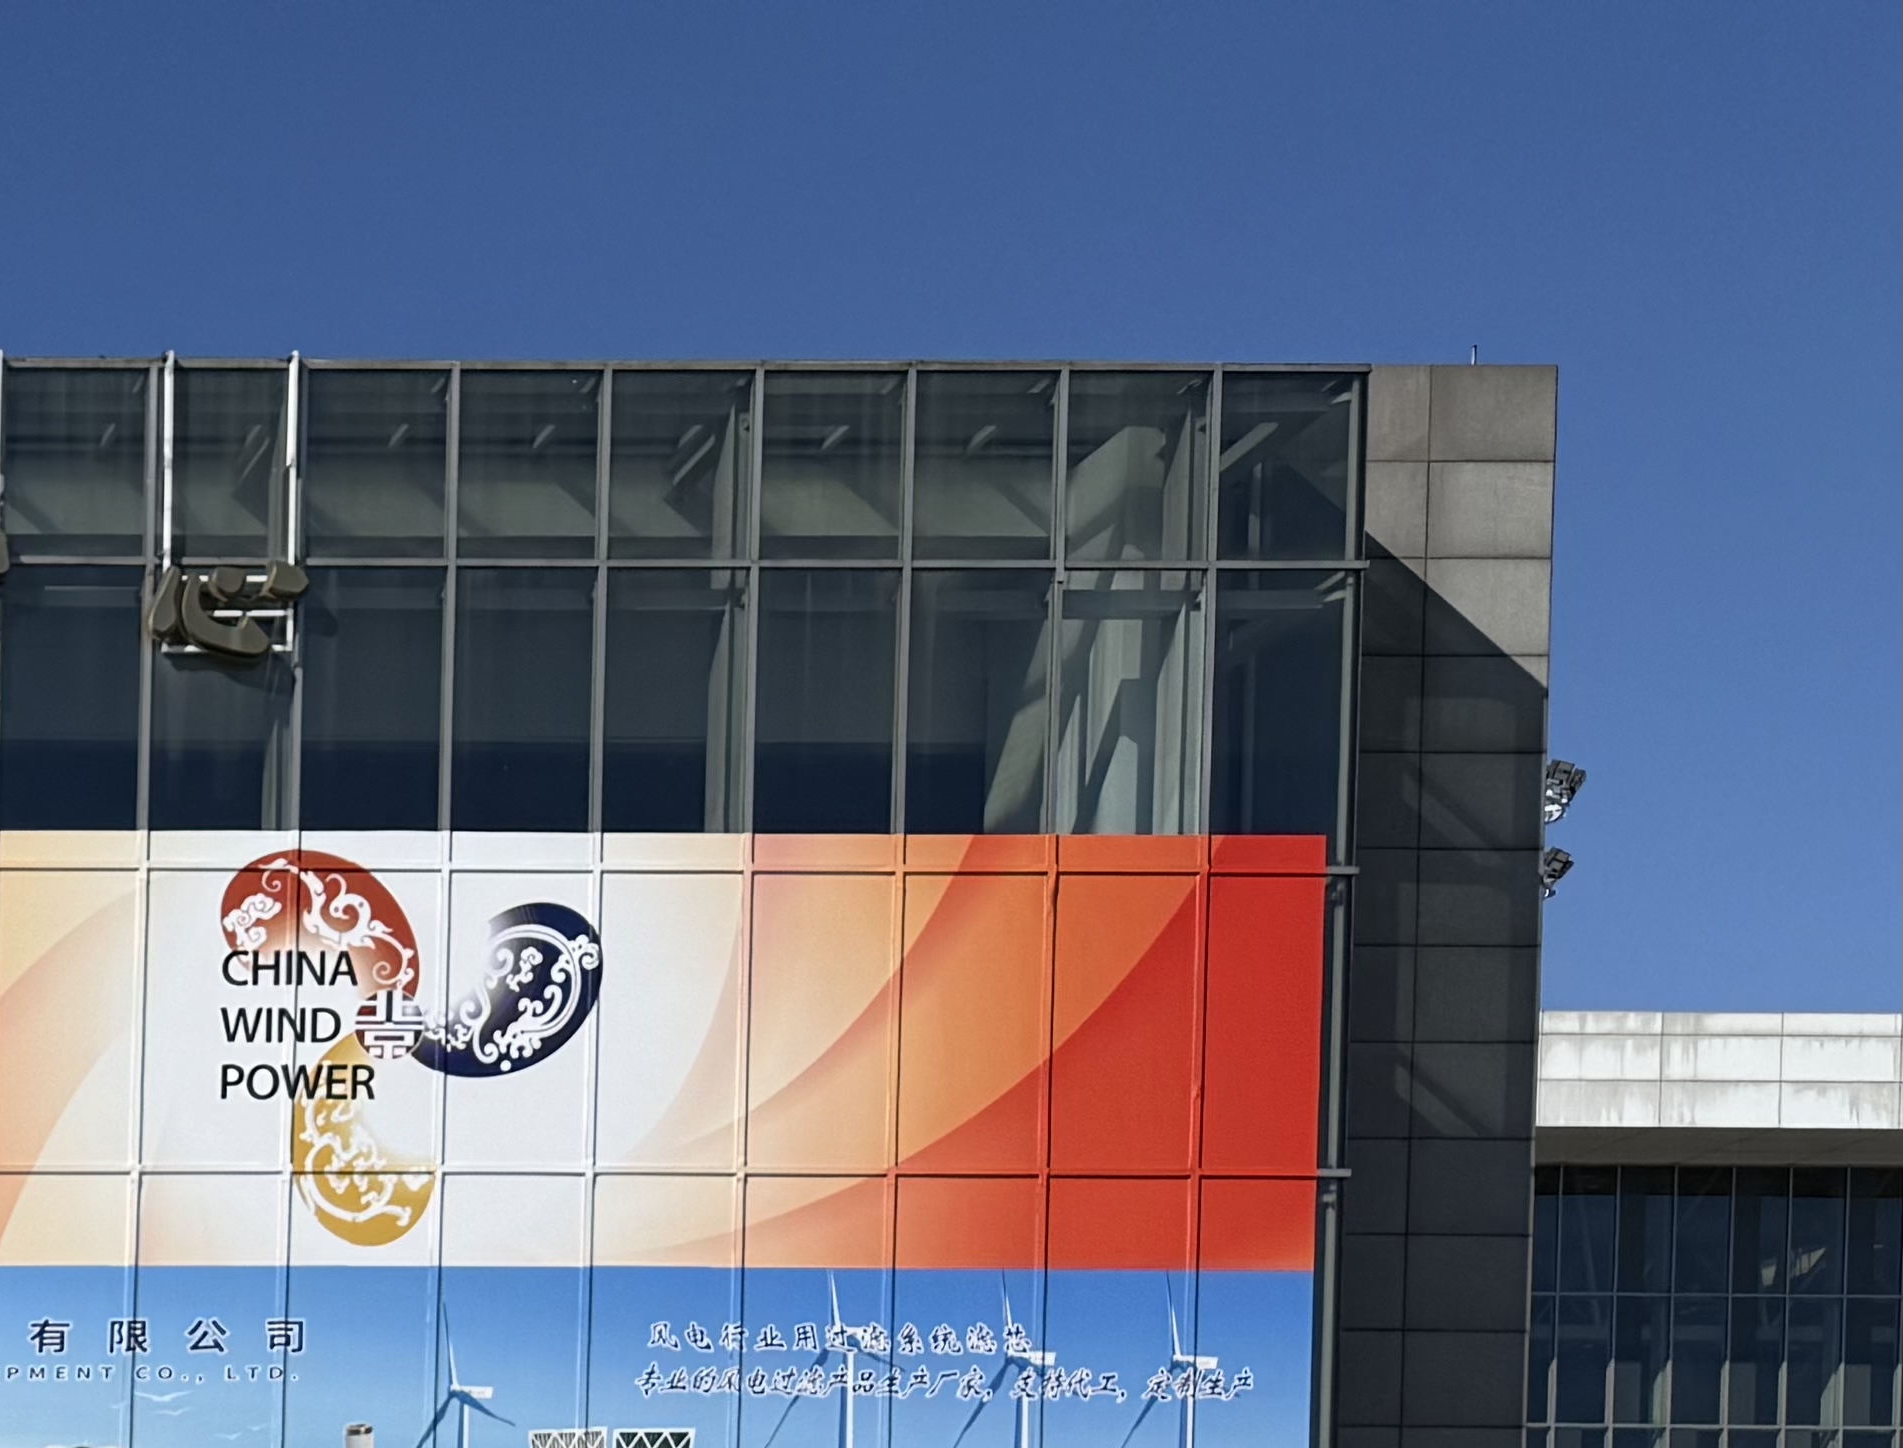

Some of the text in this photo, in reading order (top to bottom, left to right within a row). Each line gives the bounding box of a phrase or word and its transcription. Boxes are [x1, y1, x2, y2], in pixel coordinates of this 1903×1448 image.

[221, 950, 358, 987] CHINA
[220, 1007, 341, 1043] WIND
[220, 1065, 375, 1100] POWER
[136, 1367, 204, 1383] CO.,
[225, 1366, 299, 1381] LTD.
